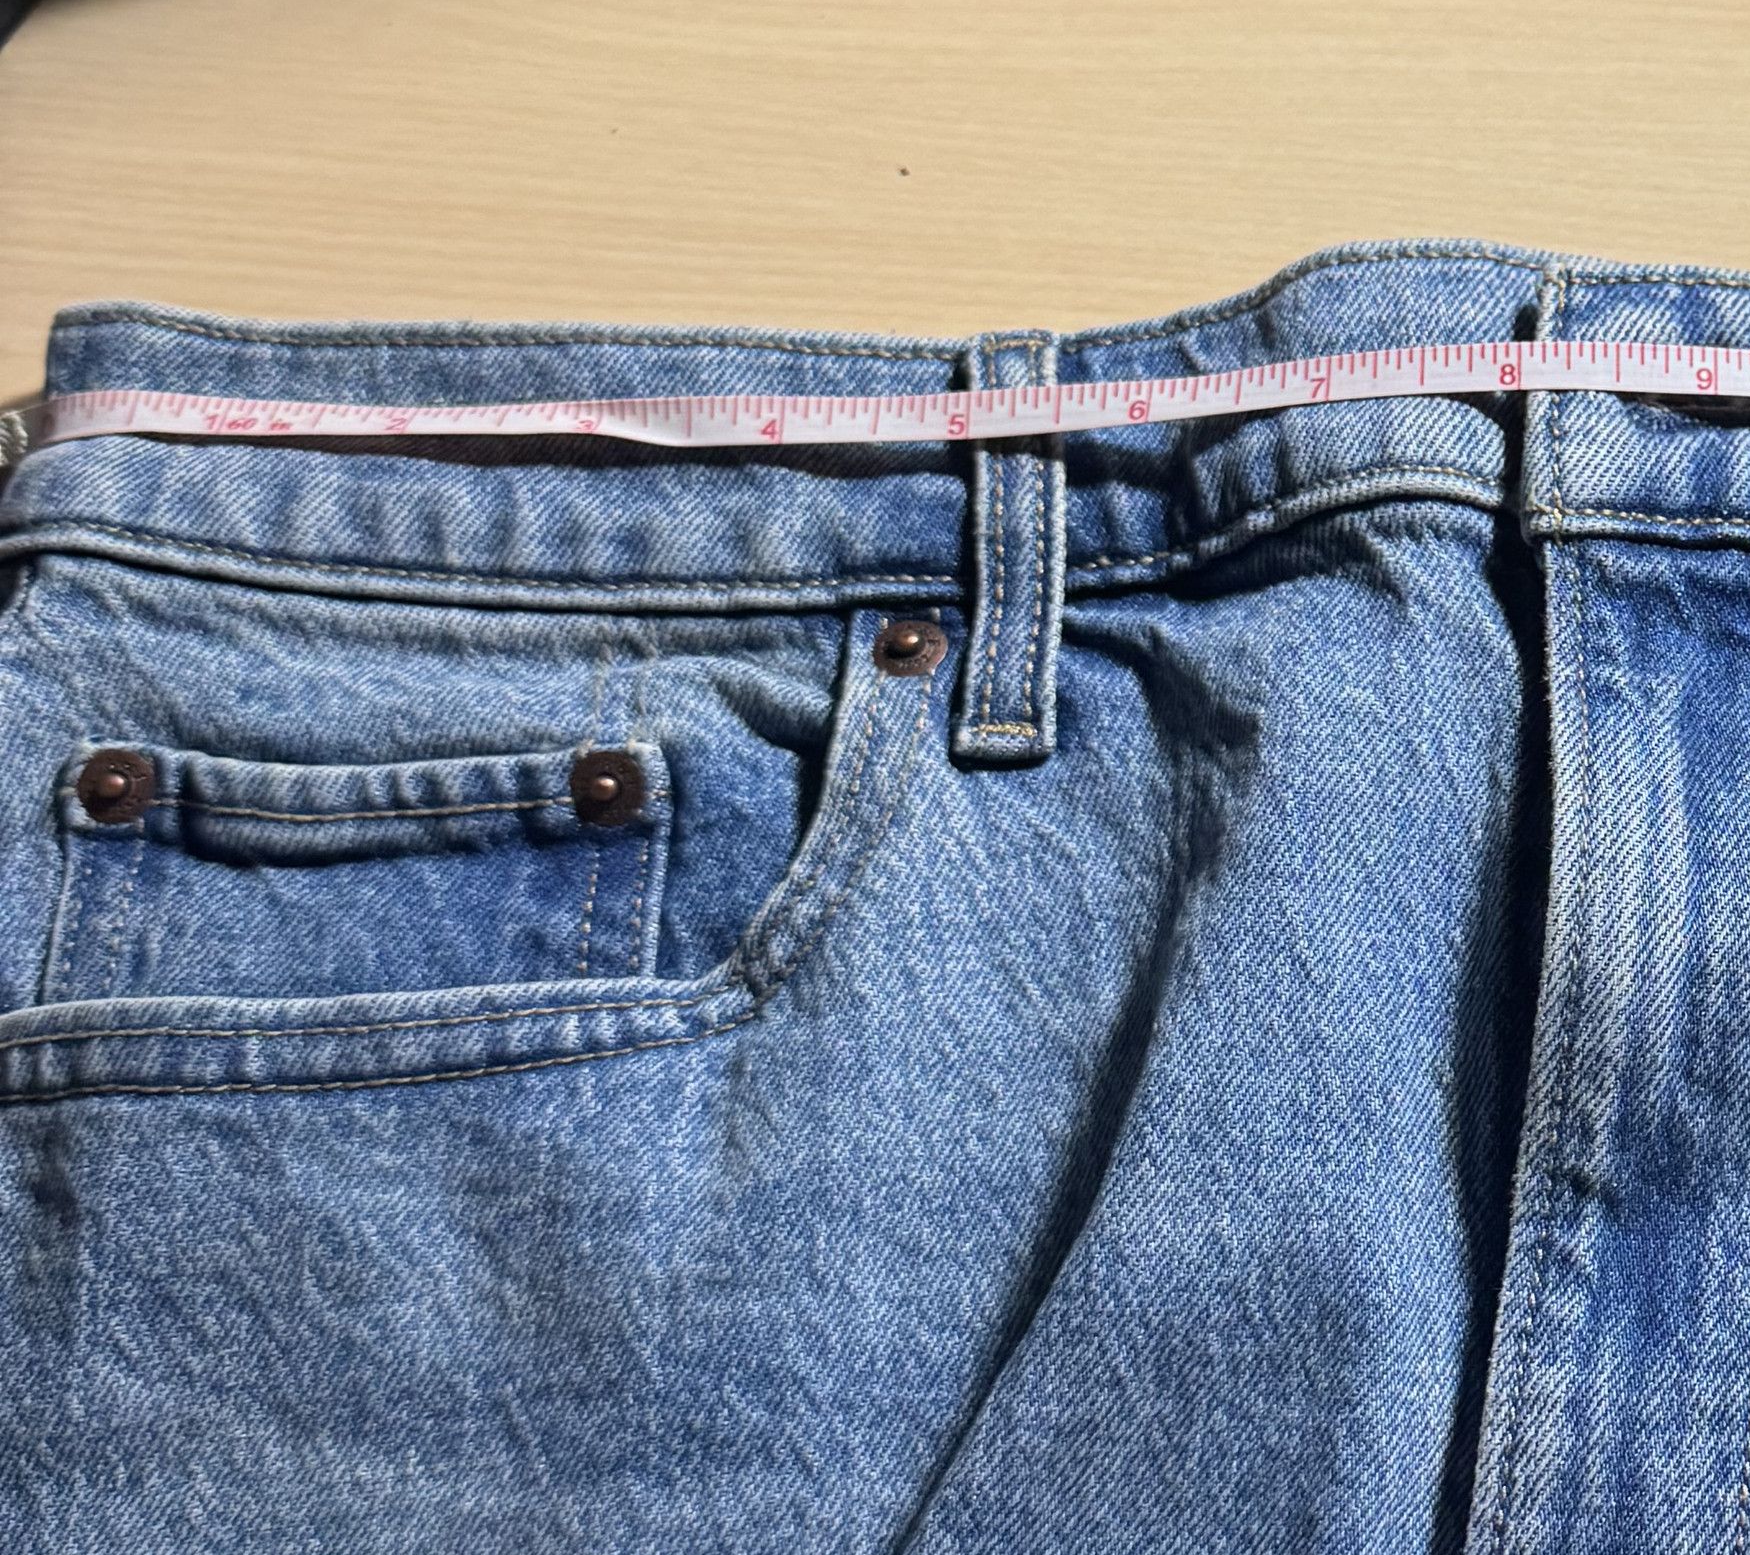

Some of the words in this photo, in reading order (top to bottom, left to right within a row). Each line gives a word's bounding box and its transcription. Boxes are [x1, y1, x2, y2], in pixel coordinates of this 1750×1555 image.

[760, 418, 777, 440] 4
[947, 413, 966, 436] 5
[1127, 399, 1147, 421] 6
[1309, 377, 1326, 400] 7
[1499, 363, 1517, 386] 8
[1695, 367, 1713, 391] 9
